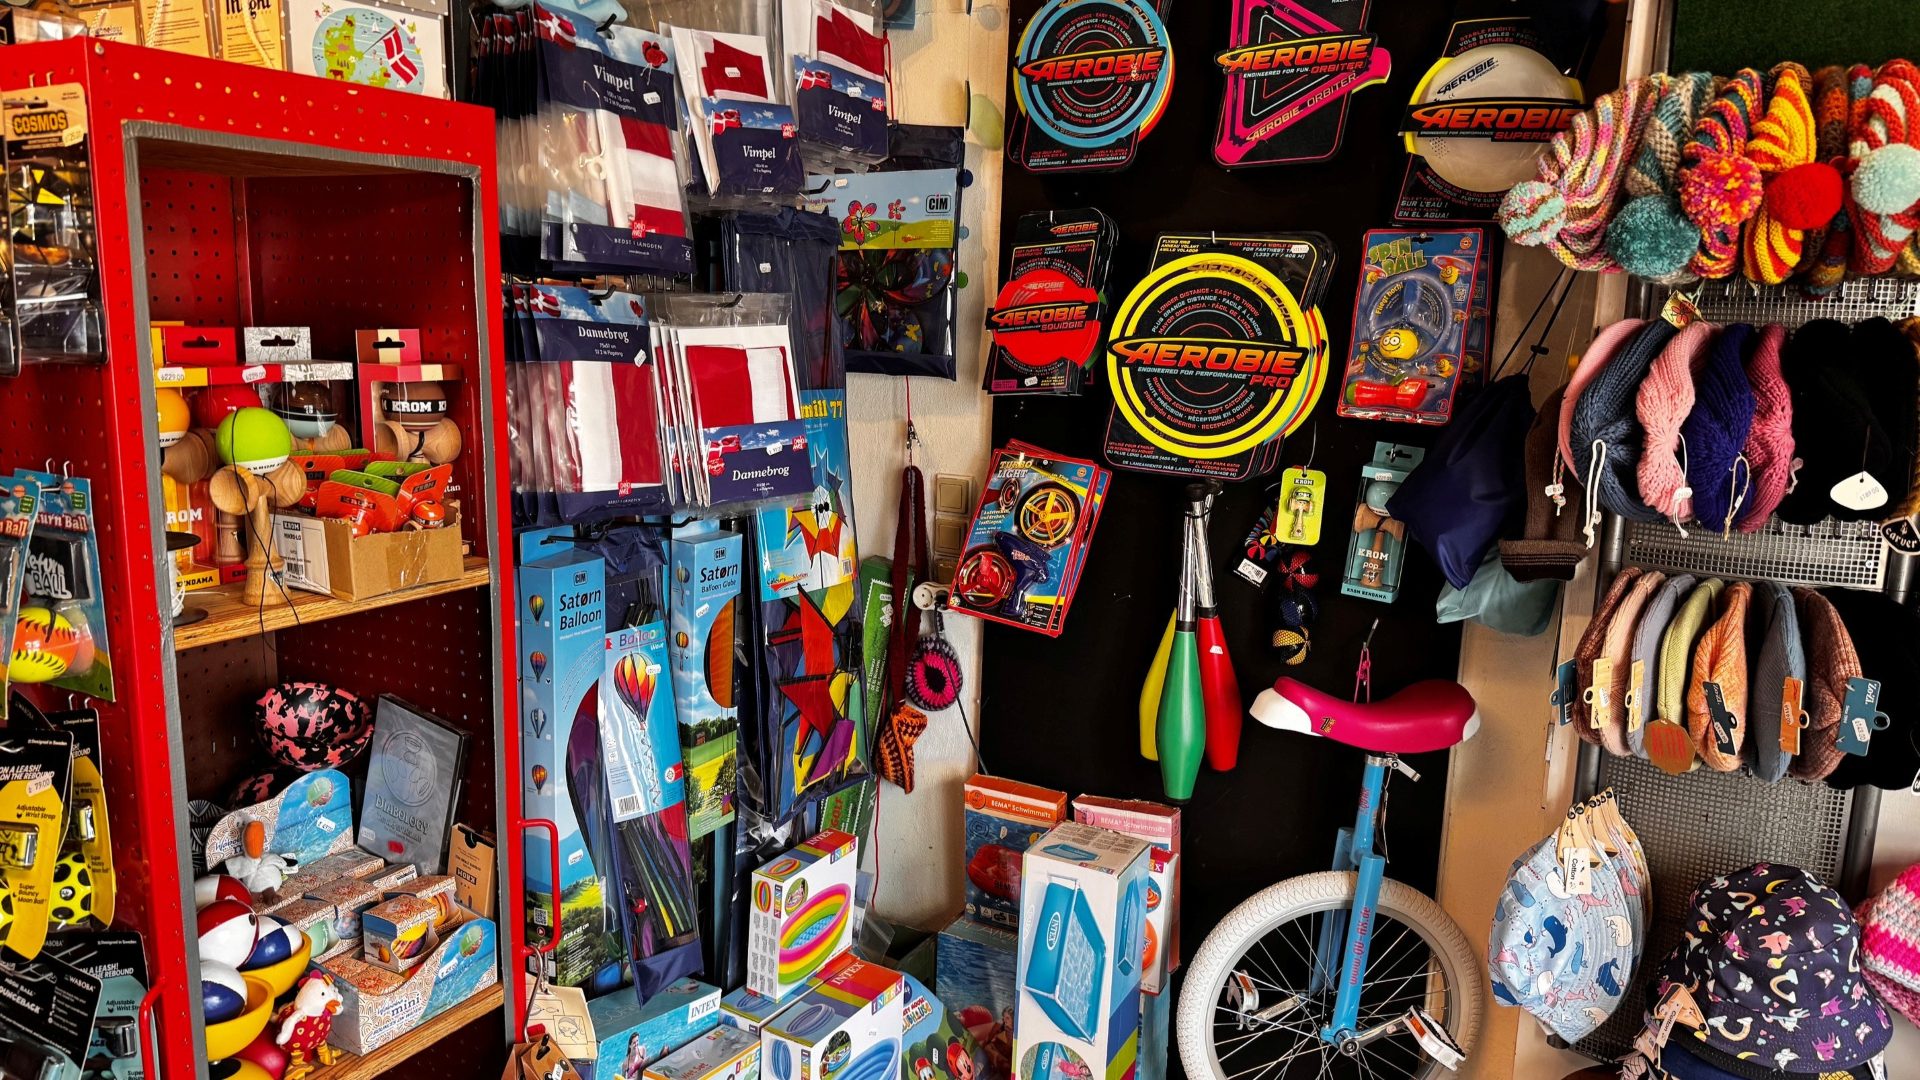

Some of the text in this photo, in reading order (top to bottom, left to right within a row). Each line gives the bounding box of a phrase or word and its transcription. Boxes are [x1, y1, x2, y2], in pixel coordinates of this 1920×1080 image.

[1459, 31, 1510, 47] VOLS STABLES
[1217, 38, 1372, 72] AEROBIE
[1021, 50, 1165, 83] AEROBIE
[1243, 69, 1281, 78] ENGINEERED
[1311, 61, 1364, 74] ORBITER
[593, 64, 634, 92] Vimpel
[1436, 57, 1496, 95] AEROBIE
[828, 104, 862, 124] Vimpel
[1246, 73, 1358, 142] AEROBIE ORBITER
[13, 110, 68, 136] COSMOS
[742, 145, 776, 160] Vimpel
[1050, 222, 1099, 234] AEROBIE
[1157, 288, 1259, 317] LONGER DISTANCE EASY TO THROW
[991, 305, 1089, 327] AEROBIE
[1151, 295, 1262, 336] PLUS GRANDE DISTANCE FACILE LANCER
[1159, 316, 1175, 334] MAYOR
[1175, 302, 1206, 317] DISTANCIA
[1229, 309, 1237, 317] DE
[578, 326, 630, 343] Dannebrog
[1041, 321, 1083, 331] SQUIDGIE
[1112, 343, 1302, 375] AEROBIE
[1137, 366, 1178, 375] ENGINEERED
[1195, 371, 1247, 380] PERFORMANCE
[1250, 374, 1291, 389] PRO
[1145, 377, 1256, 423] HAUTE PRÉCISION RÉCEPTION EN DOUCEUR
[1152, 376, 1248, 415] SUPERIOR ACCURACY SOFT CATCHES
[392, 402, 432, 412] KROM
[830, 401, 843, 418] 77
[1166, 415, 1196, 429] SUPERIOR
[732, 466, 790, 481] Dannebrog
[997, 469, 1028, 478] LIGHT
[63, 515, 88, 532] Ball
[166, 508, 203, 525] ROM
[5, 520, 27, 537] Ball
[1885, 528, 1918, 548] carver
[1358, 548, 1389, 561] KROM
[700, 564, 739, 583] Satørn
[1363, 562, 1379, 570] pop
[32, 571, 72, 599] BALL
[701, 580, 737, 593] Balloon Globe
[559, 588, 602, 612] Satørn
[560, 609, 602, 631] Balloon
[9, 765, 15, 774] A
[16, 764, 42, 773] LEASH!
[11, 772, 23, 780] THE
[23, 771, 55, 780] REBOUND
[16, 804, 46, 812] Adjustable
[375, 794, 430, 836] DIABOLOGY
[1012, 801, 1052, 818] Schwimmsitz
[40, 813, 56, 821] Strap
[807, 830, 834, 846] INTEX
[1570, 857, 1580, 881] Cotton
[19, 883, 35, 891] Super
[19, 890, 39, 898] Bouncy
[1047, 914, 1060, 949] INTEX
[95, 962, 119, 973] LEASH!
[103, 968, 134, 977] REBOUND
[831, 962, 865, 985] INTEX
[20, 985, 35, 997] BALL
[69, 976, 95, 993] WABOBA
[0, 985, 41, 1015] OUNCEBACK
[871, 976, 903, 1015] INTEX
[391, 993, 420, 1016] mini
[691, 998, 717, 1019] INTEX
[1662, 1010, 1678, 1035] Cotton
